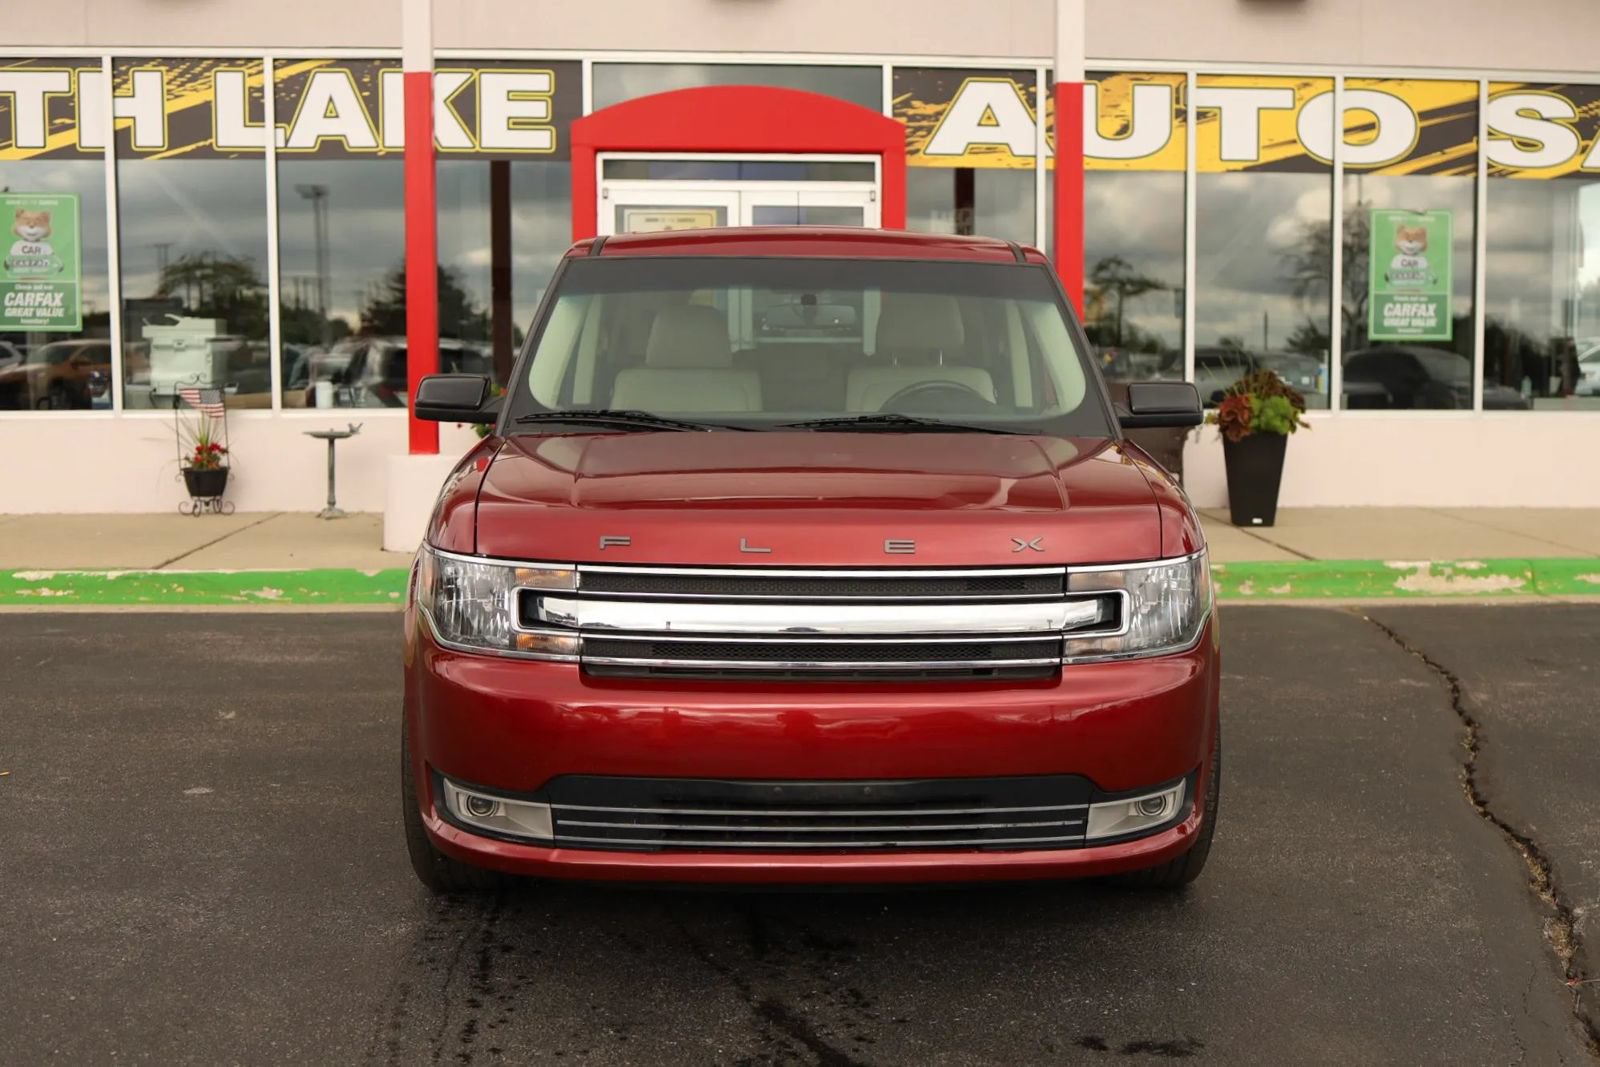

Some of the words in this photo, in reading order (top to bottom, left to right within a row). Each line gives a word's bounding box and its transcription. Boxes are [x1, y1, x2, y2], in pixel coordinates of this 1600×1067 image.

[0, 68, 167, 151] TH
[212, 68, 555, 152] LAKE
[922, 77, 1419, 166] AUTO
[1484, 89, 1600, 172] S
[4, 292, 64, 307] CARFAX
[1383, 303, 1437, 317] CARFAX
[599, 535, 1045, 554] FLEX
